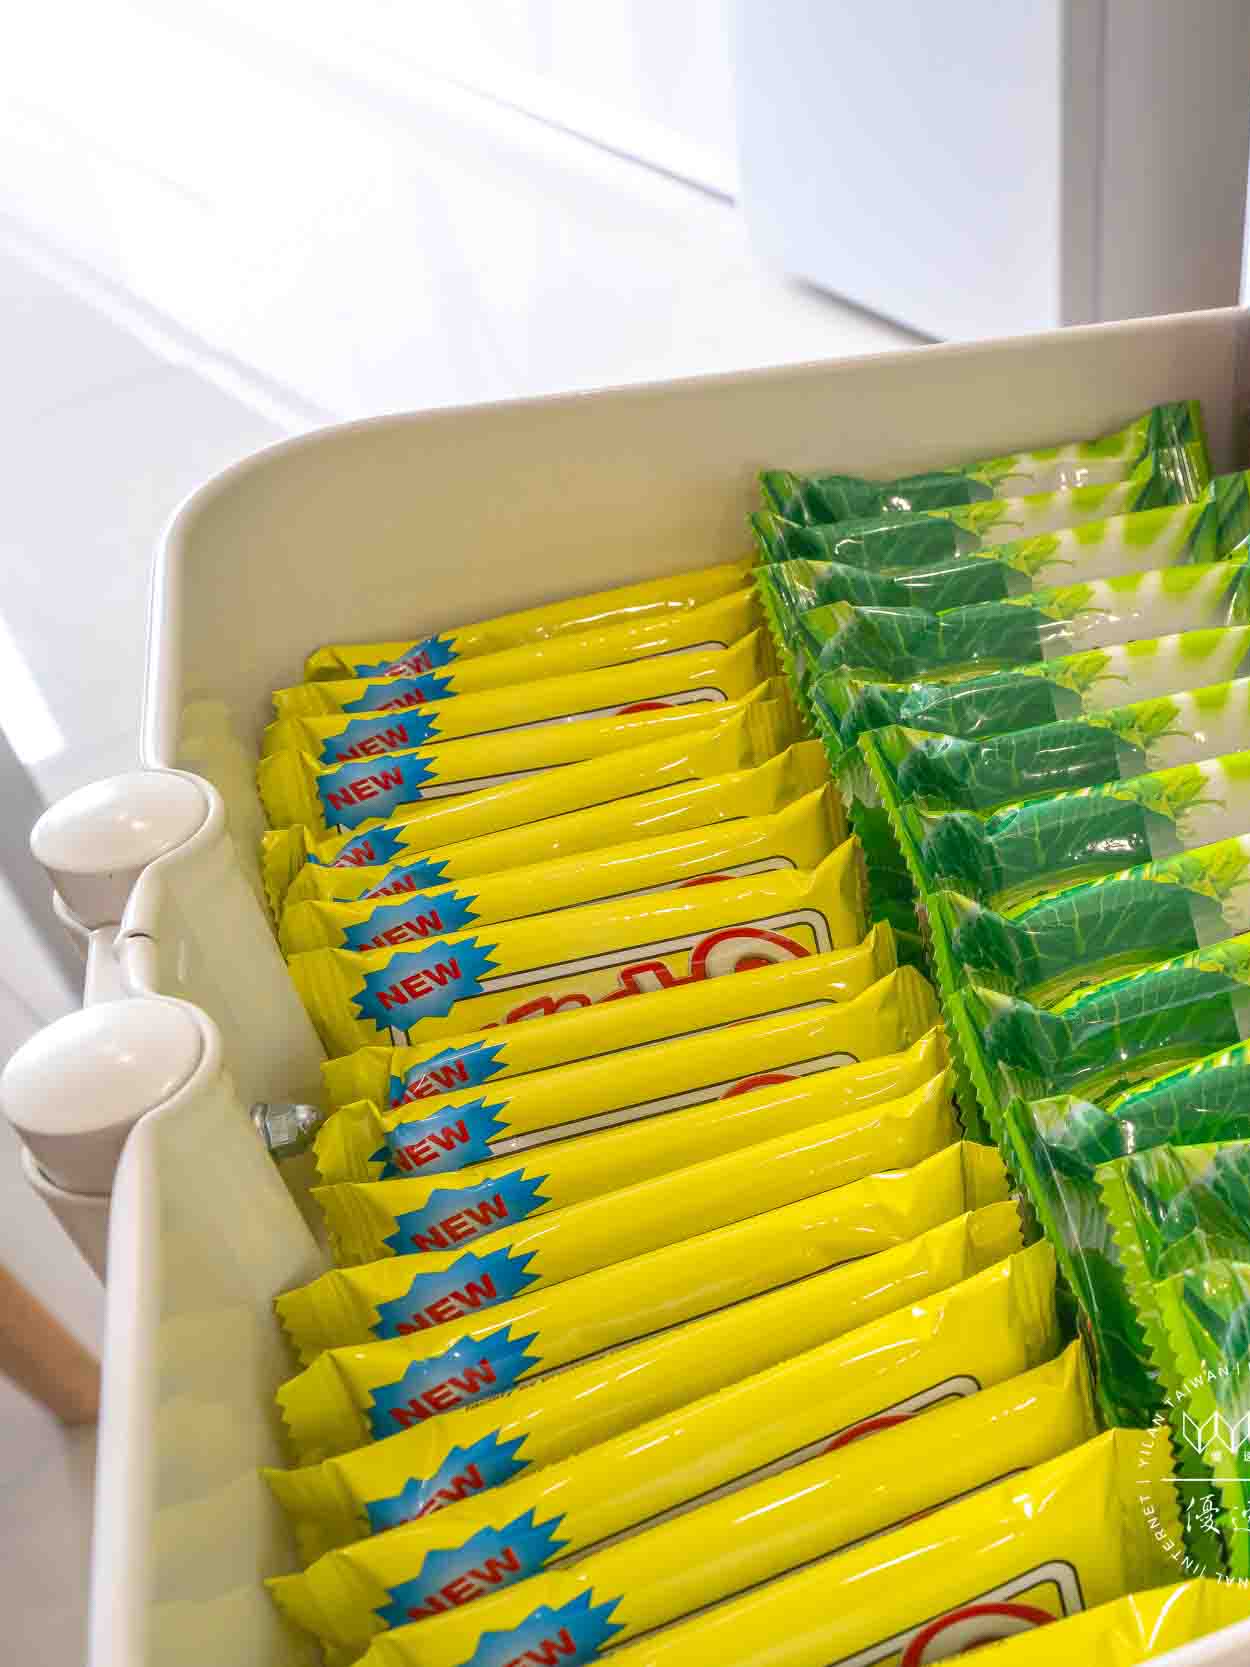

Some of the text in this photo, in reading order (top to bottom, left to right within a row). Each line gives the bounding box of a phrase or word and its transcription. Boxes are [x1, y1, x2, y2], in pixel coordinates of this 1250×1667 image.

[384, 651, 432, 677] EW
[327, 768, 404, 811] NEW
[376, 958, 461, 1011] NEW
[410, 1193, 508, 1251] NEW
[395, 1273, 497, 1335] NEW
[389, 1359, 497, 1428] NEW
[412, 1463, 484, 1515] EW
